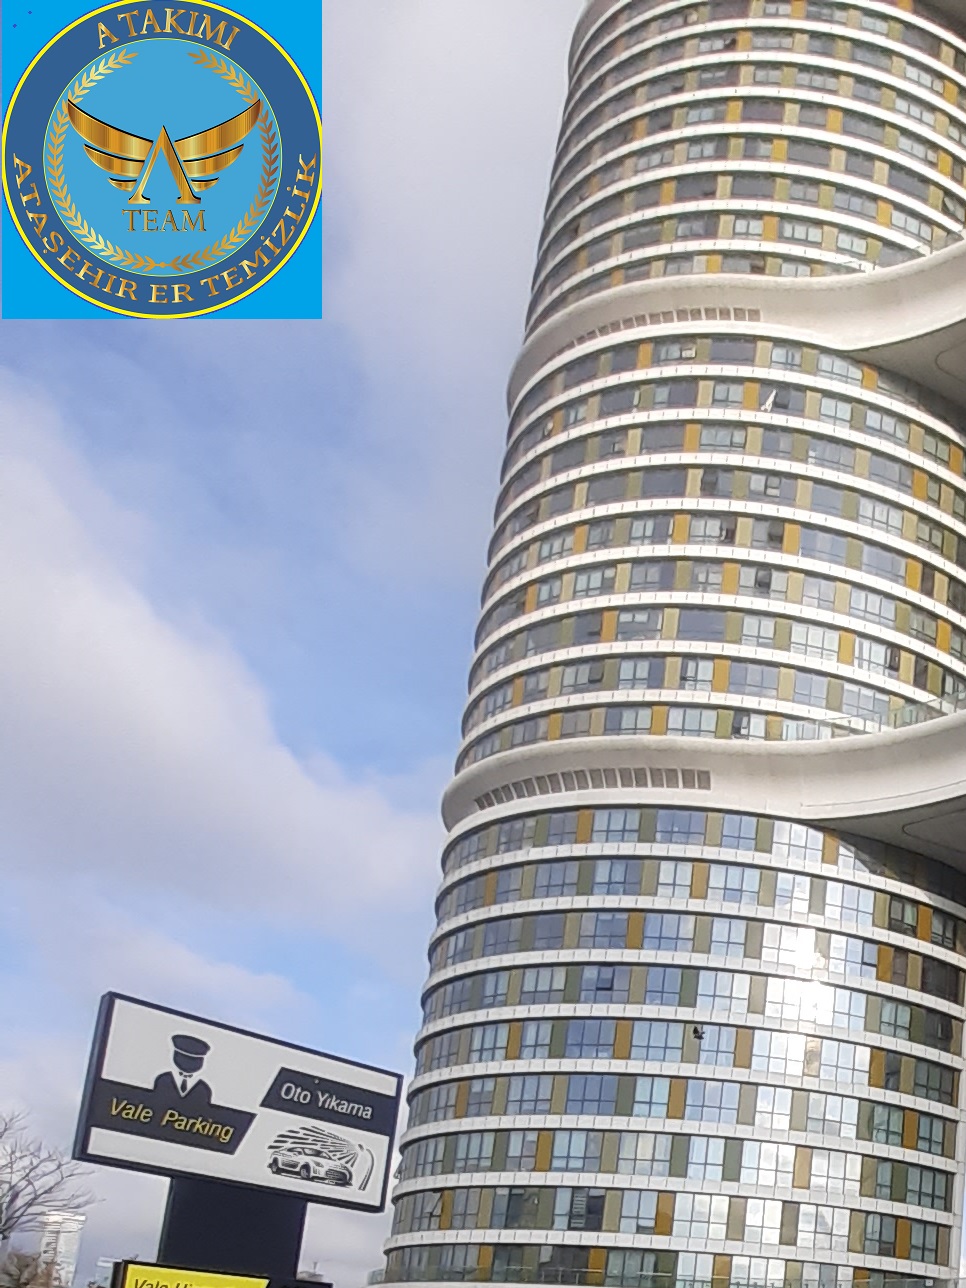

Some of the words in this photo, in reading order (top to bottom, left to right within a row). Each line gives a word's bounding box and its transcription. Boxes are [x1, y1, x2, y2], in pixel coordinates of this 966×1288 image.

[110, 1098, 153, 1123] Vale
[160, 1110, 235, 1144] Parking
[280, 1083, 311, 1105] Oto
[316, 1090, 373, 1119] Yıkama
